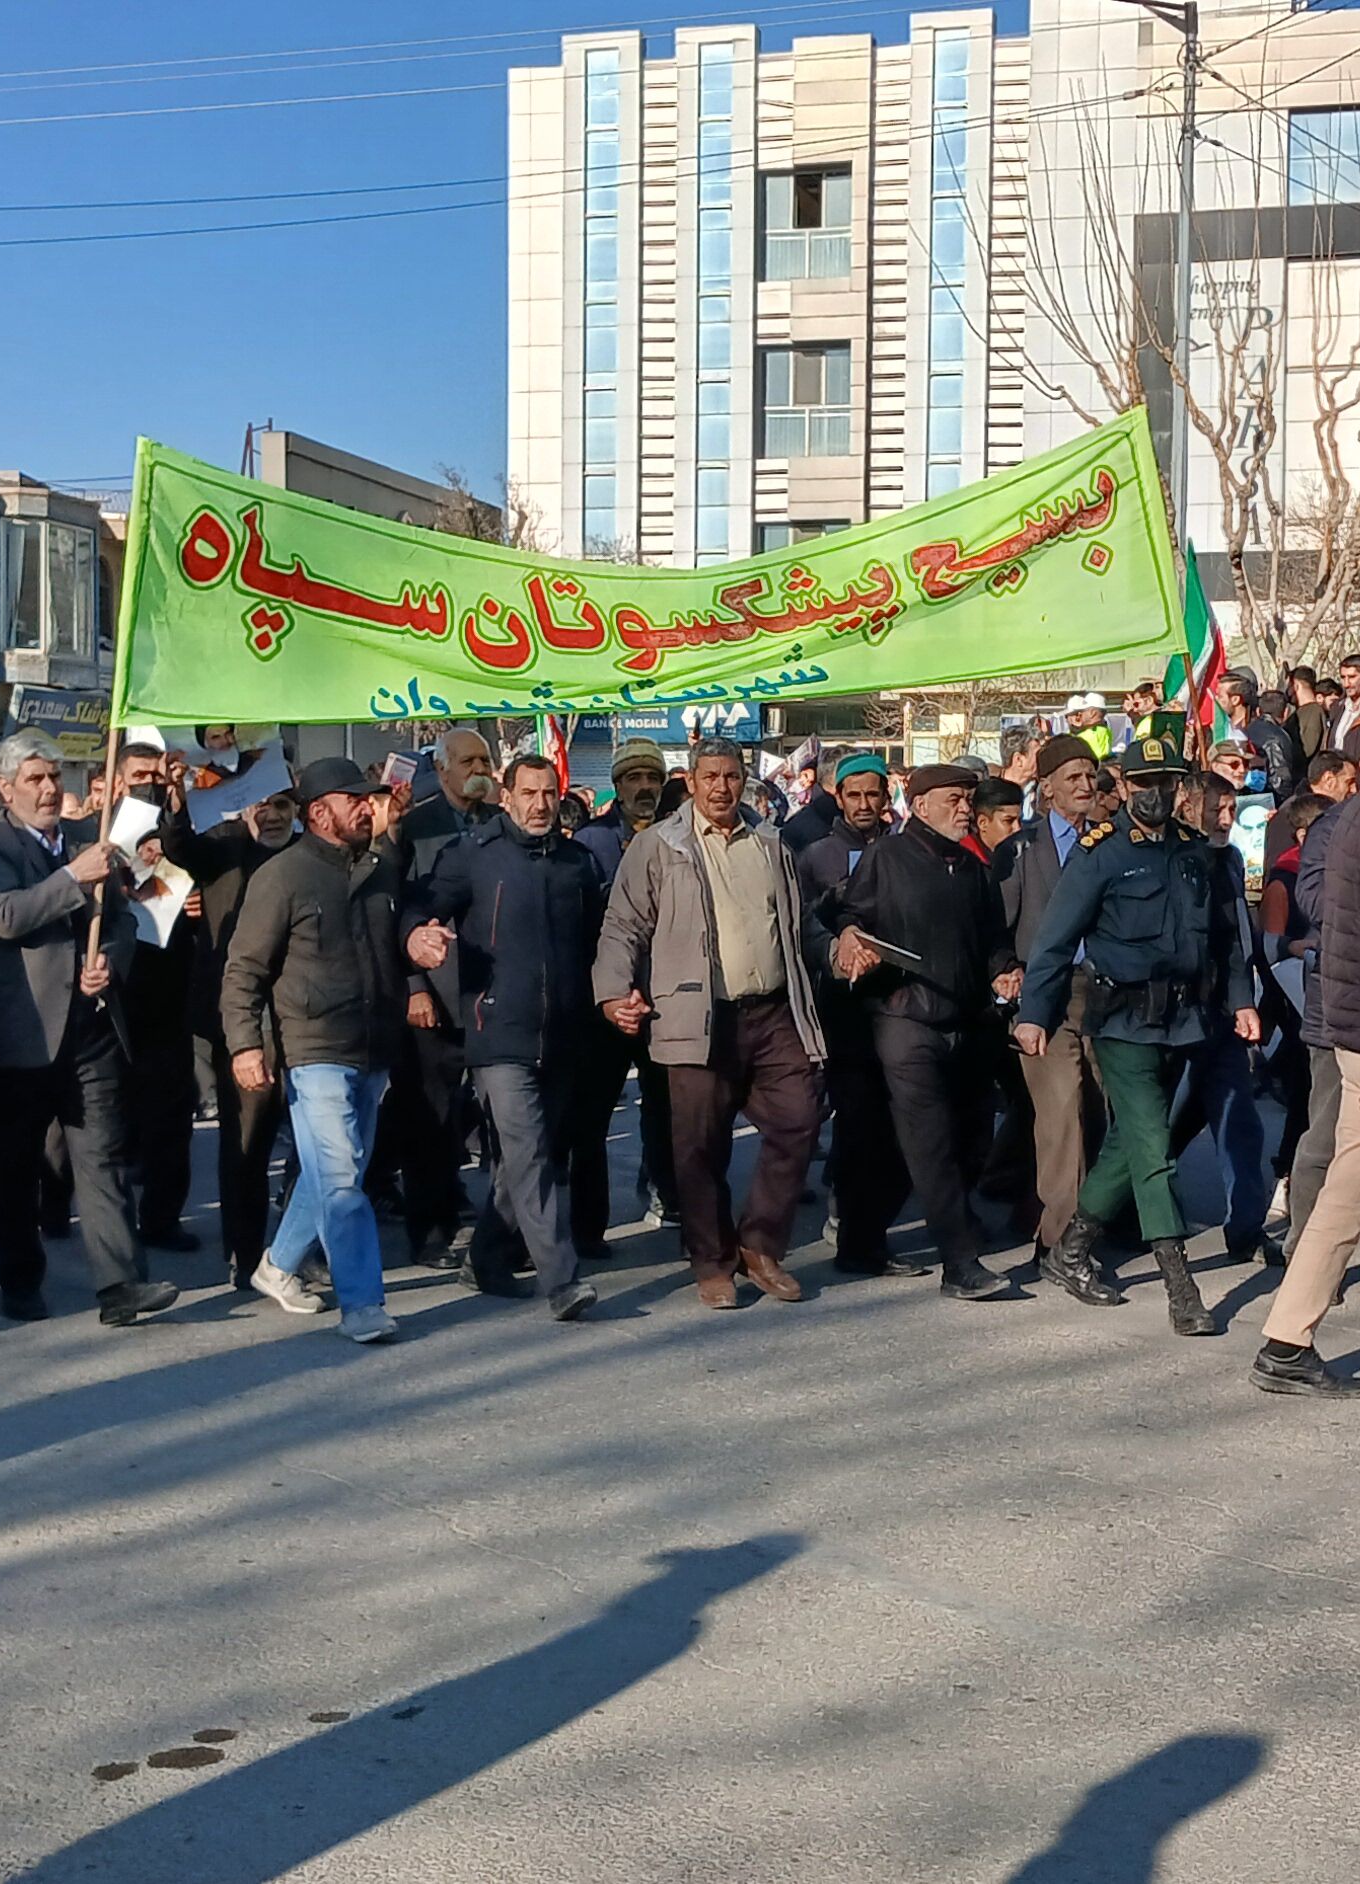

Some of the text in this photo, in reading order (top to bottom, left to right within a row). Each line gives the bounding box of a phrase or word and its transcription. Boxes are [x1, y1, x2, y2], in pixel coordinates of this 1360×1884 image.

[1190, 275, 1260, 300] hopping
[1189, 306, 1232, 321] enter
[178, 468, 1116, 672] بسیج پیشکسوتان سپاه
[625, 718, 669, 729] MOBILE
